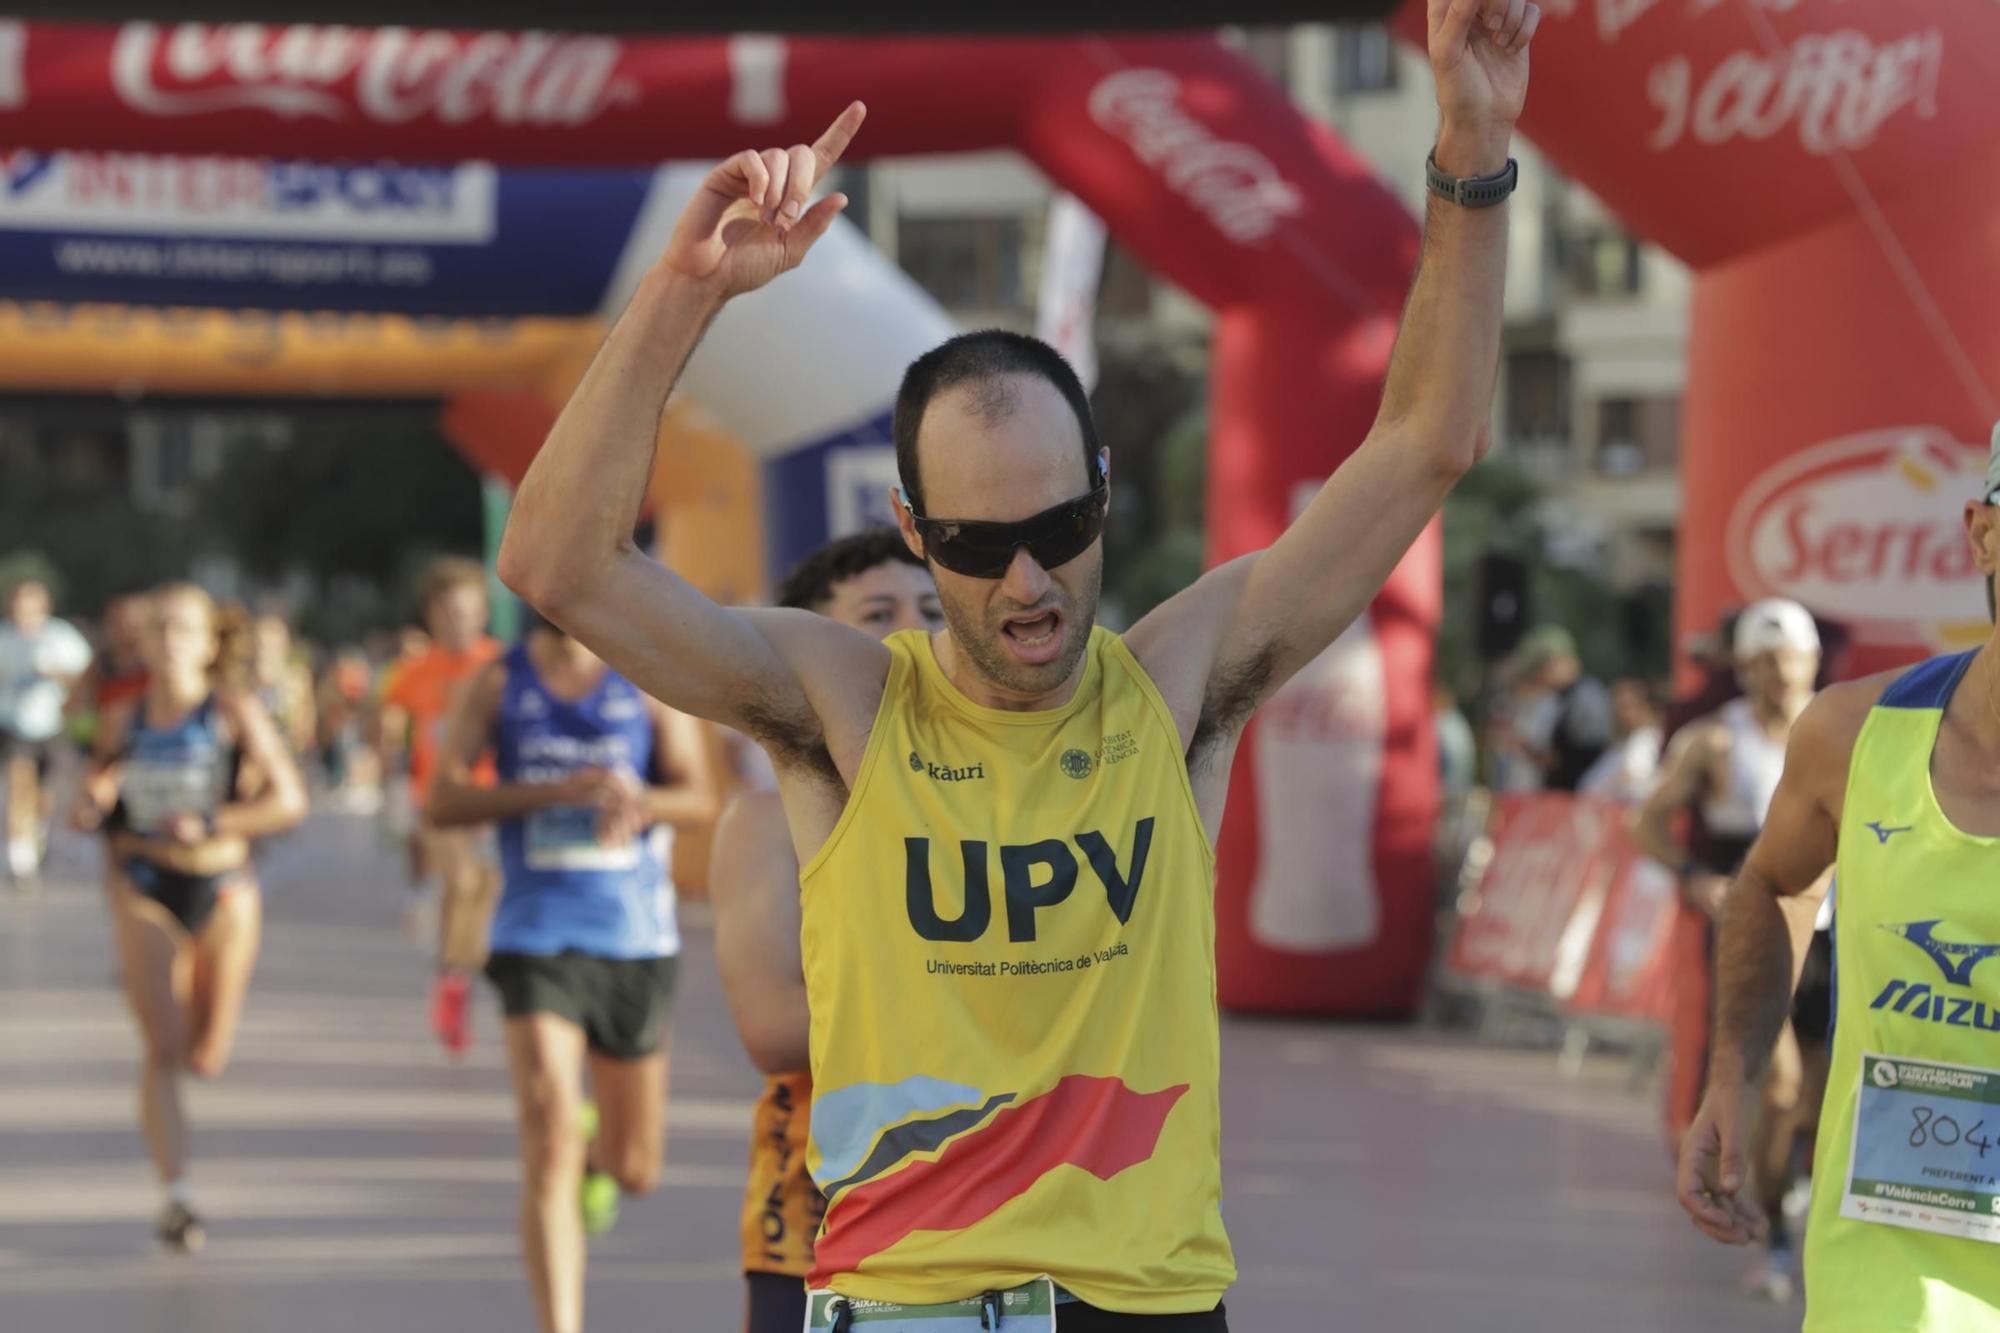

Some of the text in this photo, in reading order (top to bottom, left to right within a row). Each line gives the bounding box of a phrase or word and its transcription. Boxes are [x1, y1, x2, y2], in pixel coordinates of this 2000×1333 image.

[904, 816, 1155, 943] UPV
[926, 959, 996, 977] Universitat
[1000, 958, 1073, 976] Politècnica
[1076, 955, 1092, 969] de
[1909, 1106, 2000, 1159] 804
[1921, 1165, 1985, 1184] PREFERENT
